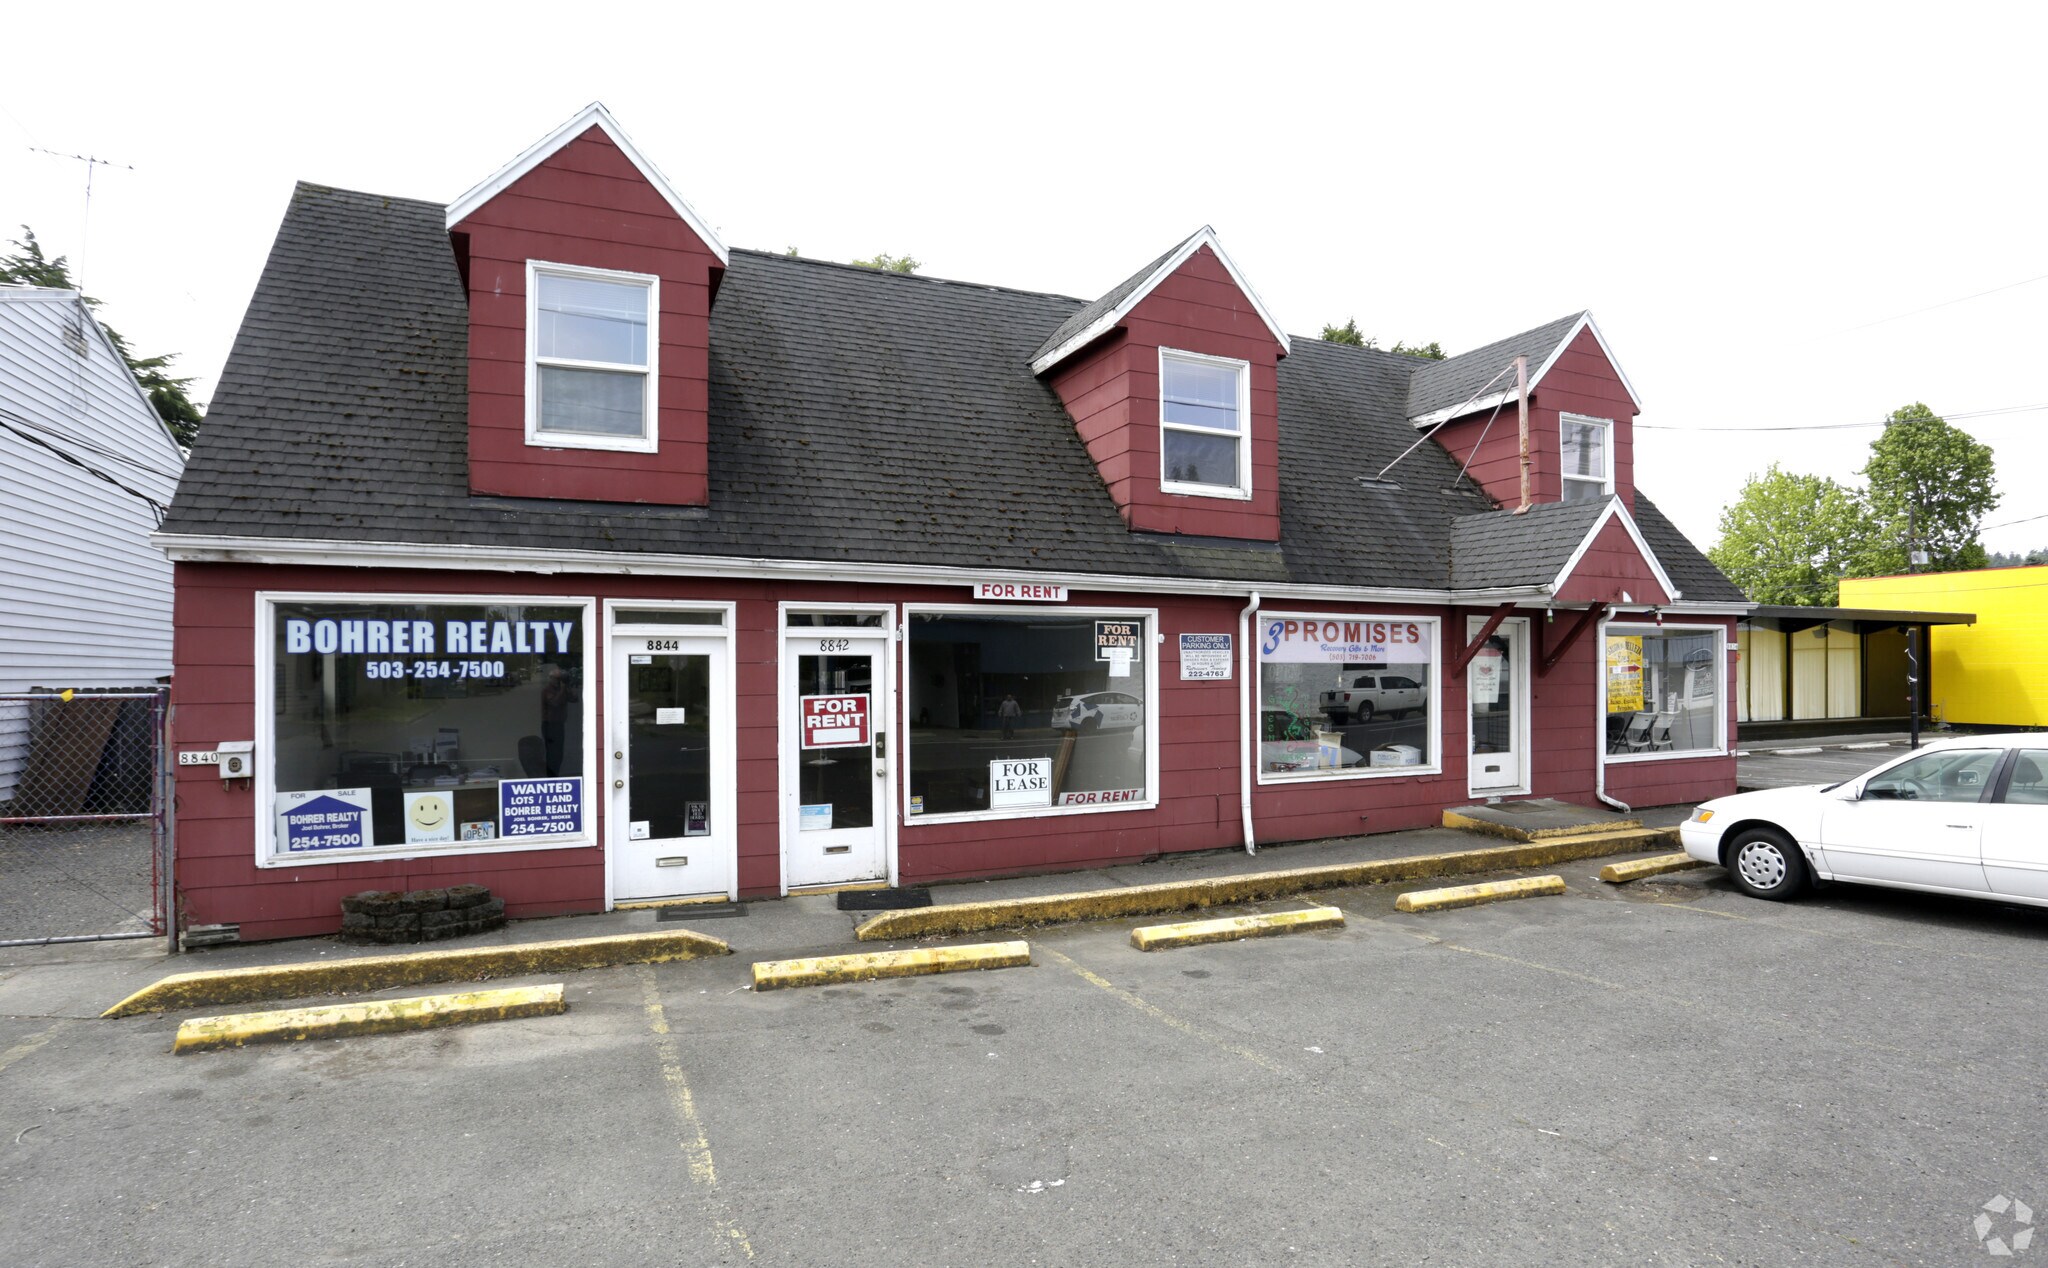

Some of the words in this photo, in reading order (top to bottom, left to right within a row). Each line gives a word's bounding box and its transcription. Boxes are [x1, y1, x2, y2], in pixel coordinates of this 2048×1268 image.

[982, 584, 1015, 597] FOR
[1021, 585, 1061, 598] RENT
[286, 619, 436, 654] BOHRER
[445, 620, 573, 654] REALTY
[1103, 624, 1131, 635] FOR
[1098, 635, 1137, 647] RENT
[1262, 622, 1284, 655] 3
[1284, 621, 1420, 644] PROMISES
[647, 640, 679, 651] 8844
[820, 639, 849, 652] 8842
[1320, 645, 1346, 653] Recovery
[366, 660, 505, 679] 503-254-7500
[813, 699, 857, 713] FOR
[807, 713, 864, 728] RENT
[181, 753, 218, 763] 8840
[1003, 762, 1039, 776] FOR
[511, 782, 573, 795] WANTED
[995, 777, 1048, 791] LEASE
[511, 796, 534, 805] LOTS
[546, 794, 573, 803] LAND
[1065, 793, 1097, 804] FOR
[1101, 790, 1138, 801] RENT
[504, 806, 541, 816] BOHRER
[545, 804, 579, 814] REALTY
[289, 813, 325, 825] BOHRER
[326, 811, 359, 822] REALTY
[466, 827, 489, 839] OPEN
[510, 821, 574, 835] 254-7500
[291, 833, 360, 849] 254-7500
